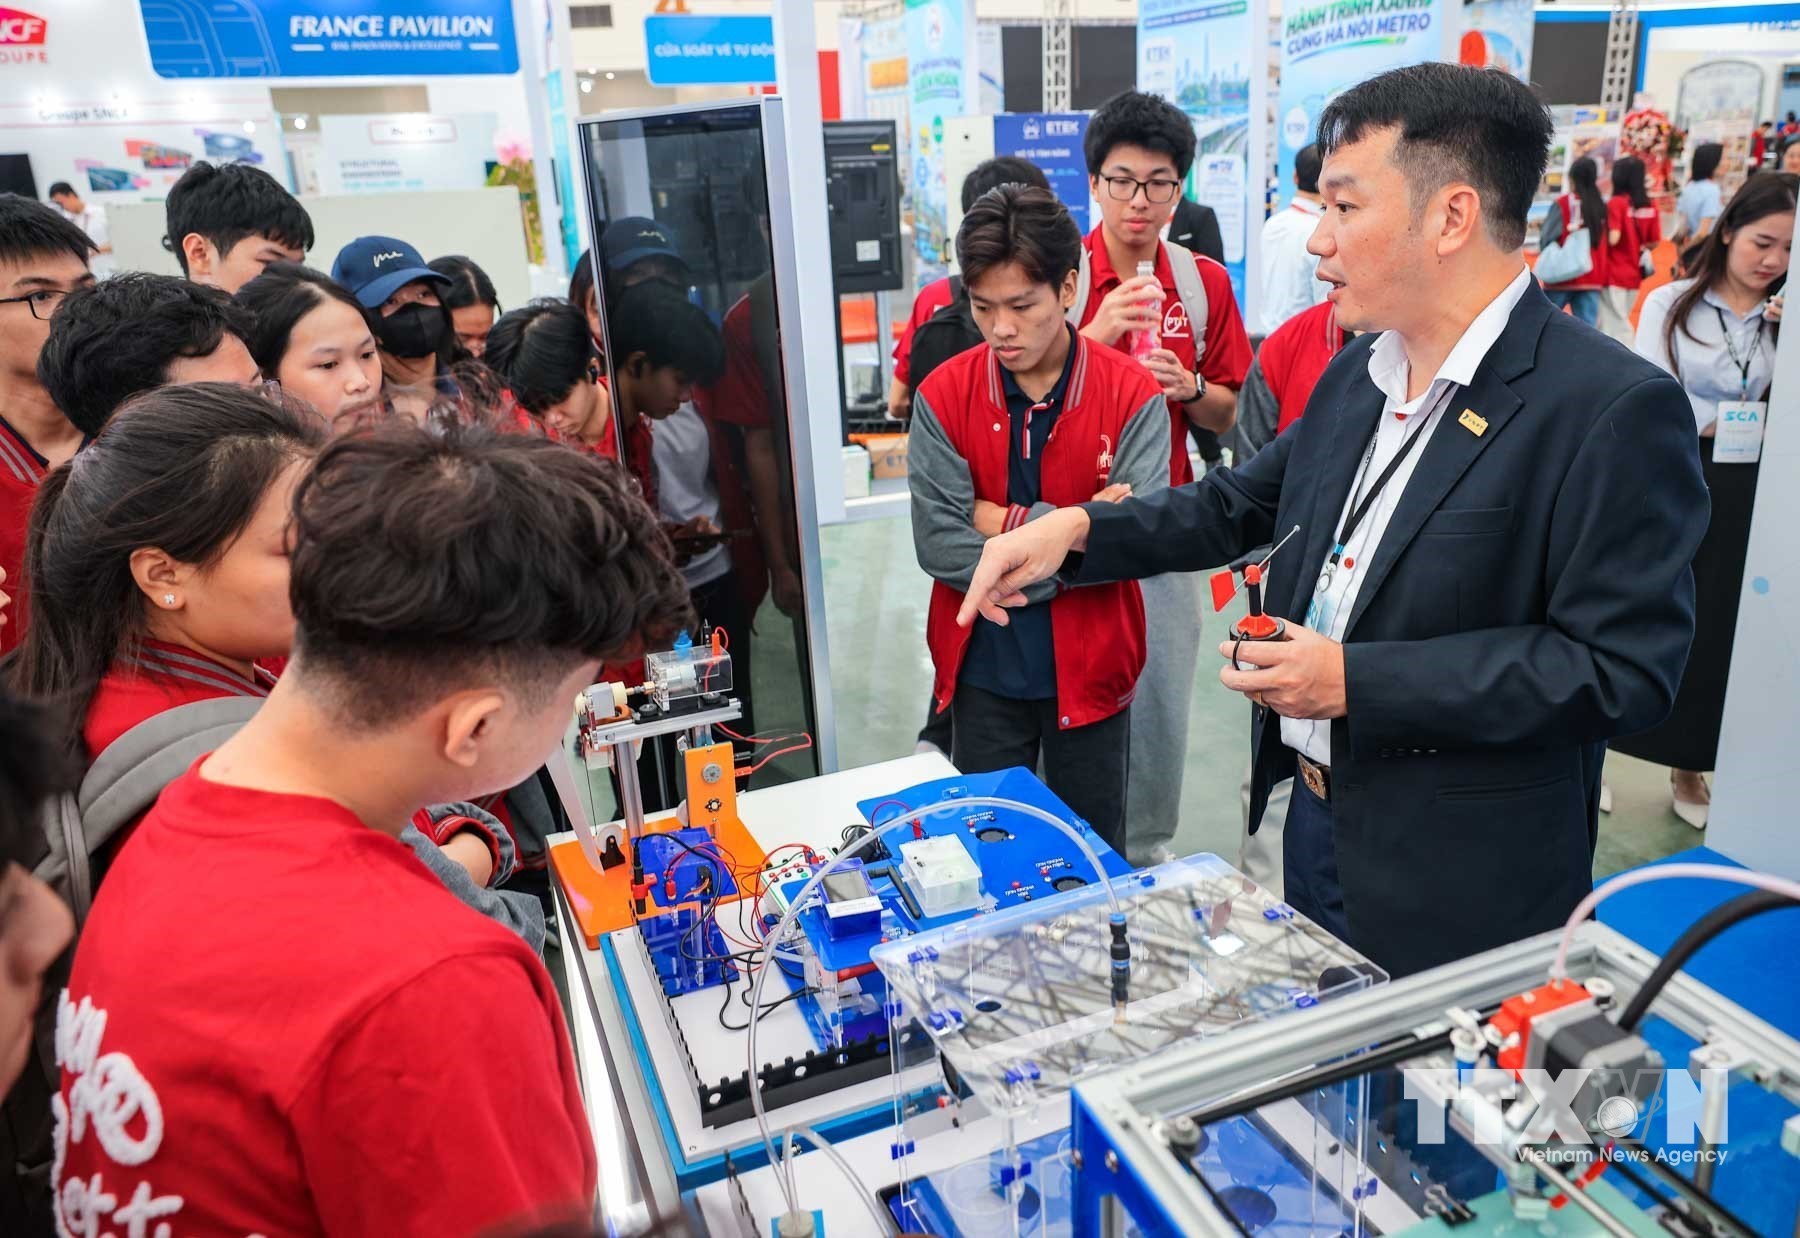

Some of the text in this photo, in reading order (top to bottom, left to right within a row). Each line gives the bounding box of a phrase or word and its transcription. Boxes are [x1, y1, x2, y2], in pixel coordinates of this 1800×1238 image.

[289, 15, 494, 38] FRANCE PAVILION
[1375, 13, 1431, 34] METRO
[1046, 120, 1079, 136] ETEK
[1724, 410, 1758, 422] SCA
